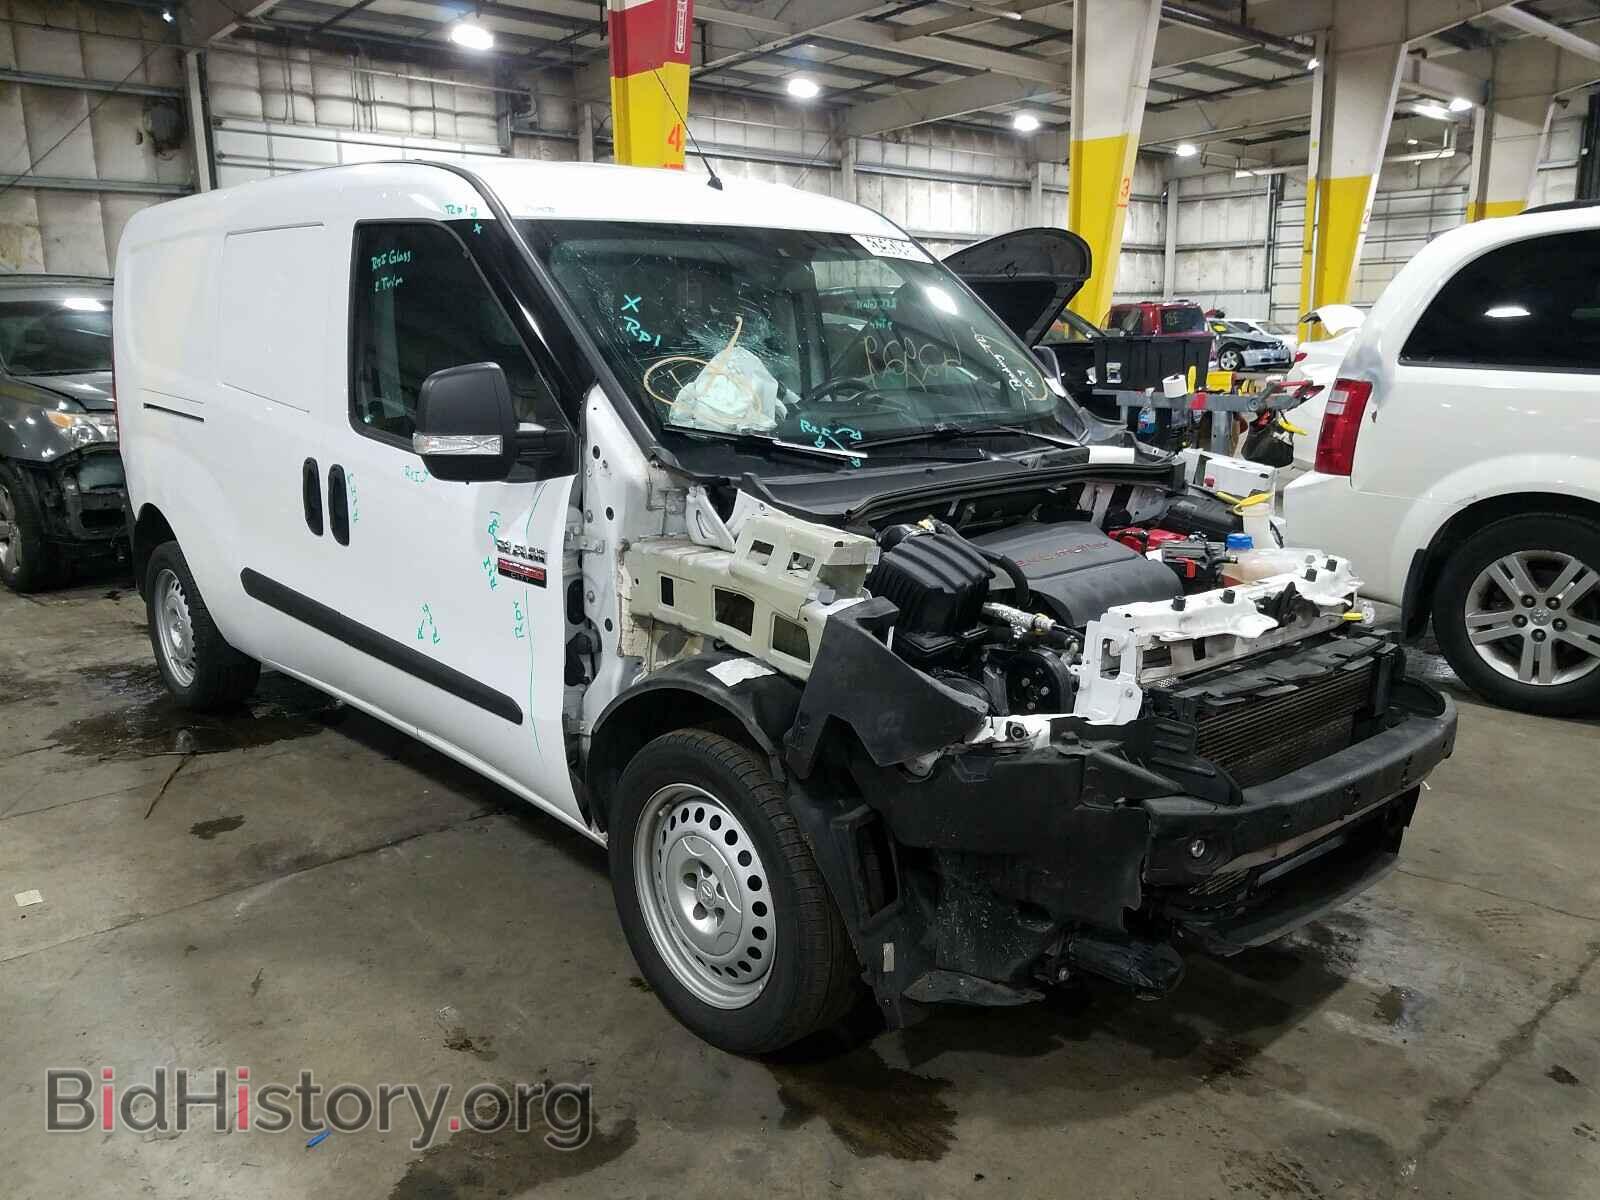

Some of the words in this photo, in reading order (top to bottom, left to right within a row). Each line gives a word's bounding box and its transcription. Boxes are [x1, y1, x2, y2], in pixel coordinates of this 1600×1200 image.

[667, 123, 682, 153] 4
[1120, 177, 1130, 197] 3
[1362, 208, 1370, 225] 2
